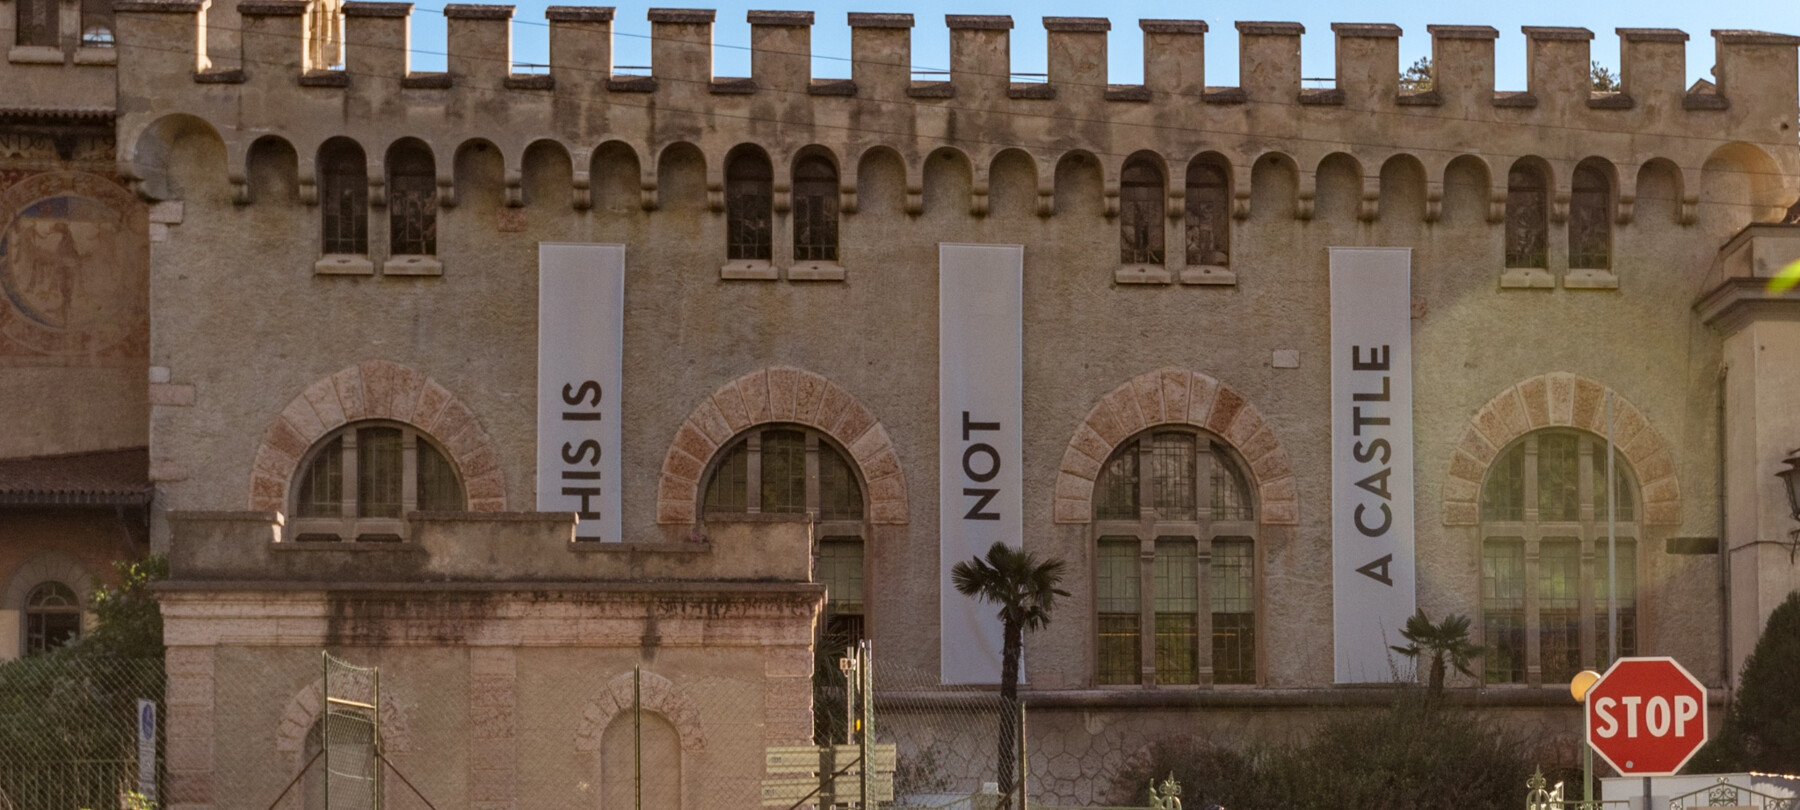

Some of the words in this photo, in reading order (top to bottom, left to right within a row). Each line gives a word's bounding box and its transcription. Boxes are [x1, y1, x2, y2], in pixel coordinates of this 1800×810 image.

[562, 380, 602, 421] IS
[1352, 344, 1393, 538] CASTLE
[962, 411, 1001, 520] NOT
[1354, 553, 1393, 588] A
[1594, 695, 1698, 738] STOP
